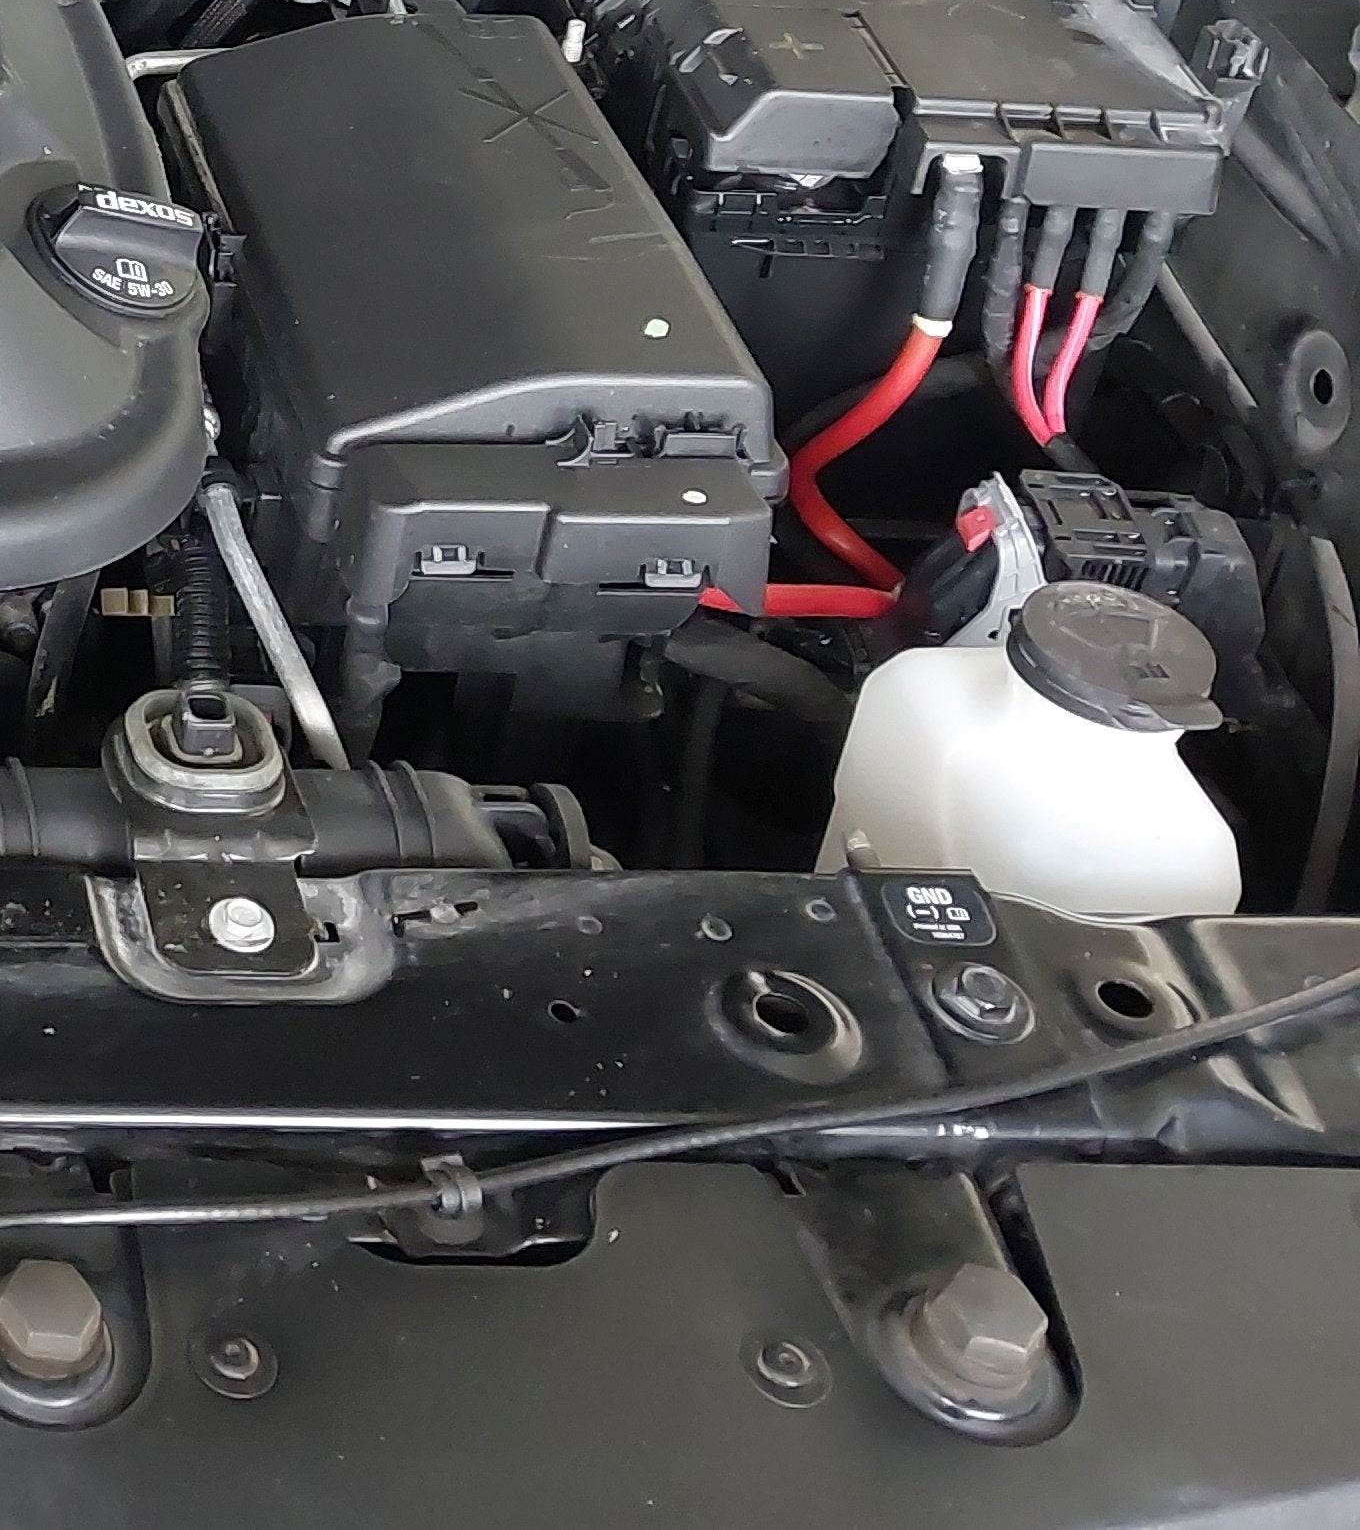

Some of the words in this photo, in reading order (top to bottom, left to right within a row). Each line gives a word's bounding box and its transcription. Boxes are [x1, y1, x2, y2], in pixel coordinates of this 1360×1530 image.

[95, 190, 195, 227] dexos
[92, 268, 123, 291] SAE
[127, 280, 174, 298] 5W-30
[906, 886, 954, 905] GND
